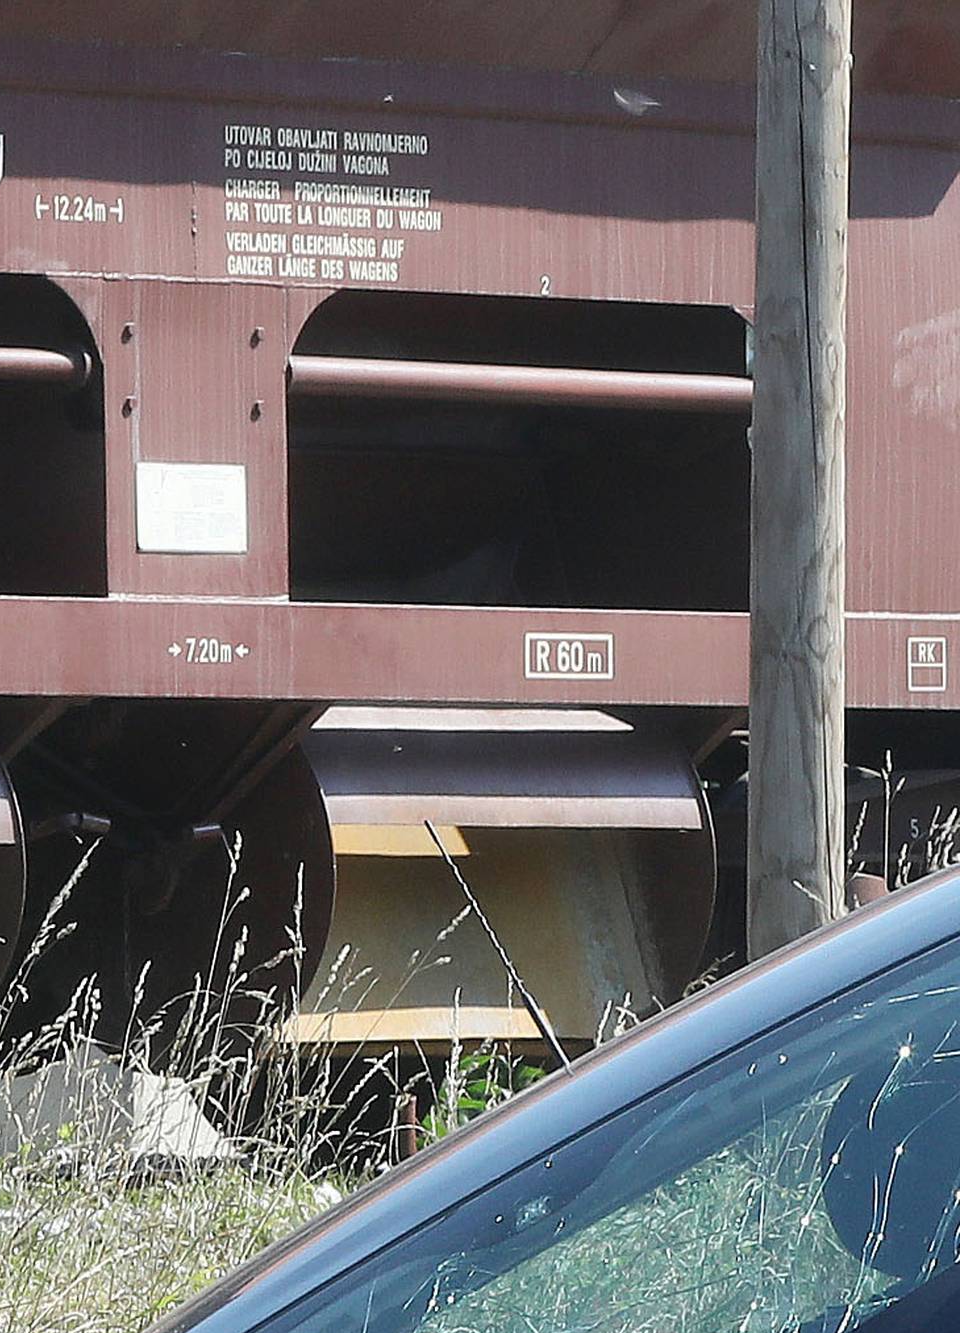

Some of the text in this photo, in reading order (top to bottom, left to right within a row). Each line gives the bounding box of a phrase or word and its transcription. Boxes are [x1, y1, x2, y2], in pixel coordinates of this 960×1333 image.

[225, 125, 428, 155] UTOVAR OBAVLJATI RAVNOMJERNO
[224, 149, 389, 175] PO CIJELOJ DUŽINI VAGONA
[225, 179, 281, 201] CHARGER
[54, 195, 106, 222] 12.24m
[225, 201, 441, 231] PAR TOUTE LA LONGUER DU WAGON
[226, 232, 404, 259] VERLADEN GLEICHMÄSSIG AUF
[227, 254, 398, 282] GANZER LÄNGE DES WAGENS
[541, 275, 550, 295] 2
[185, 637, 232, 663] 7.20m
[536, 640, 551, 673] R
[918, 642, 936, 663] RK
[910, 818, 919, 839] 5
